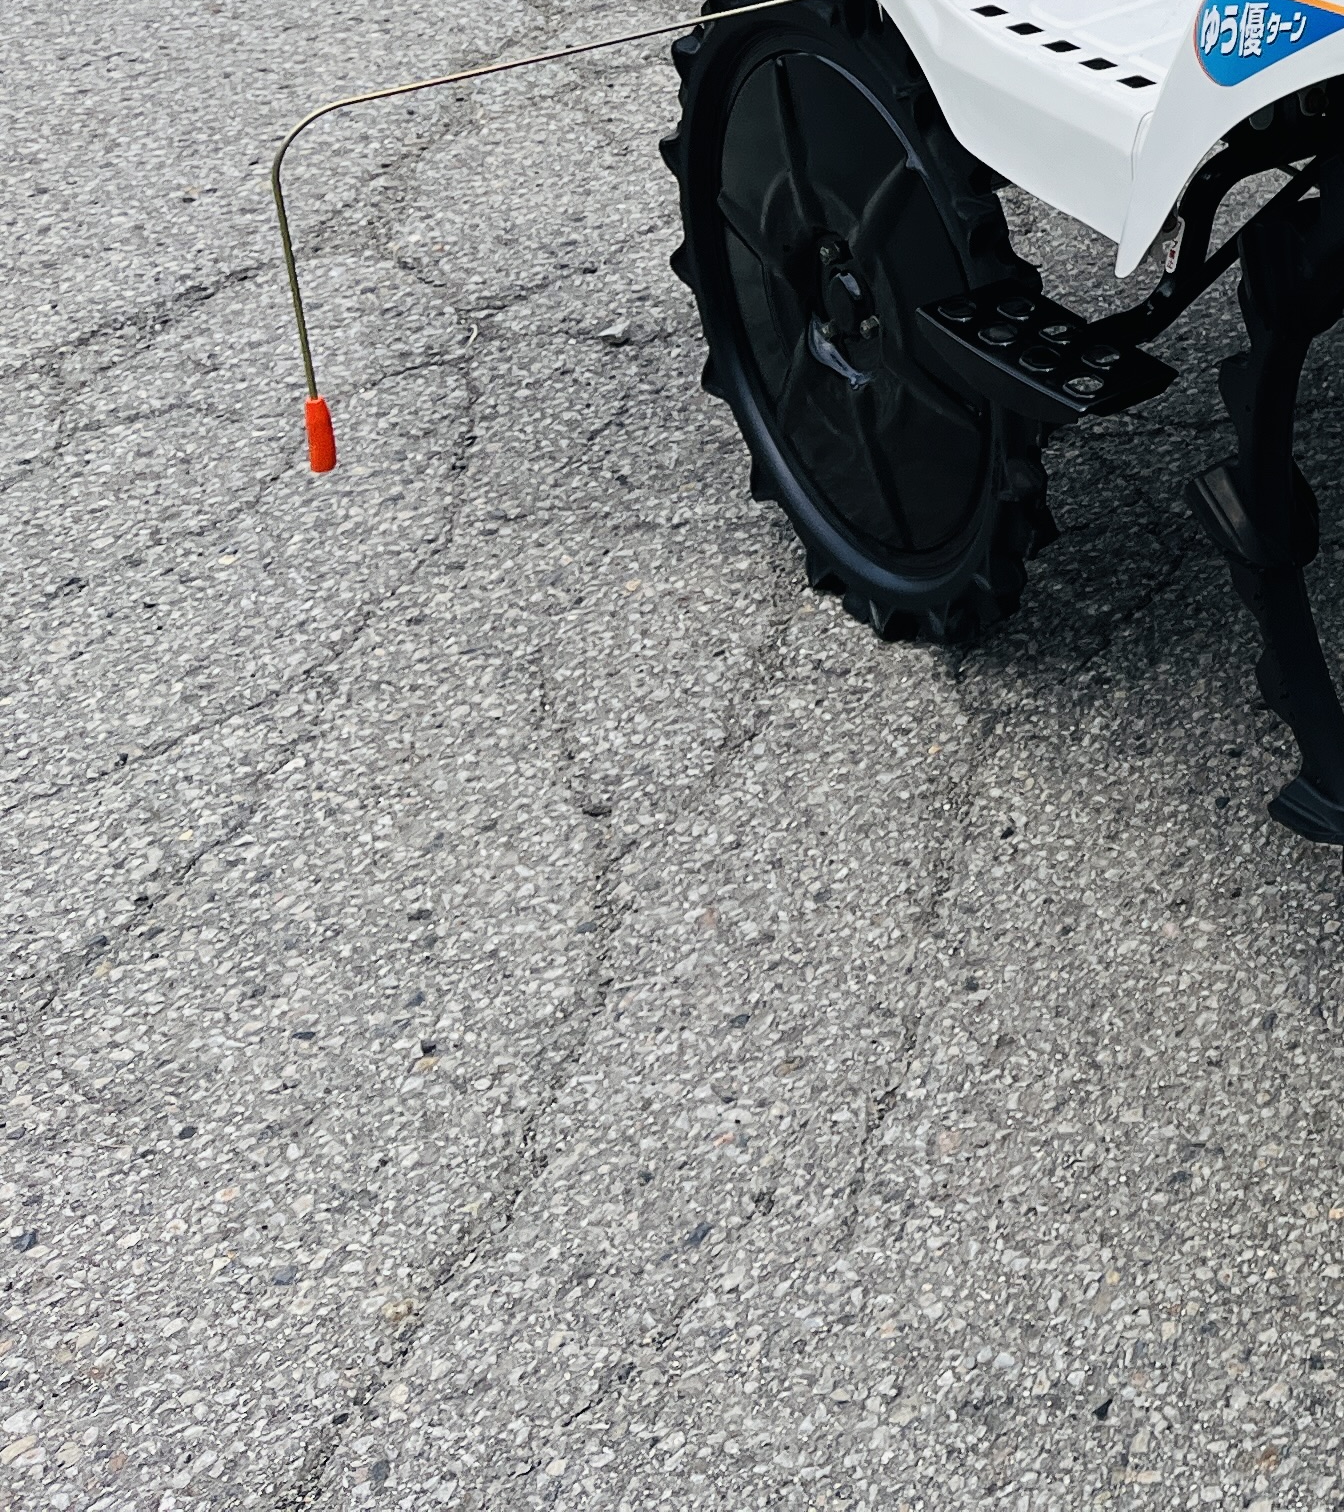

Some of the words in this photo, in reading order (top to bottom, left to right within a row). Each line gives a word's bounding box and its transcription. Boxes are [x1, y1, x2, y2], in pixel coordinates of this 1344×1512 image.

[1200, 1, 1307, 58] ゆう優ターン
